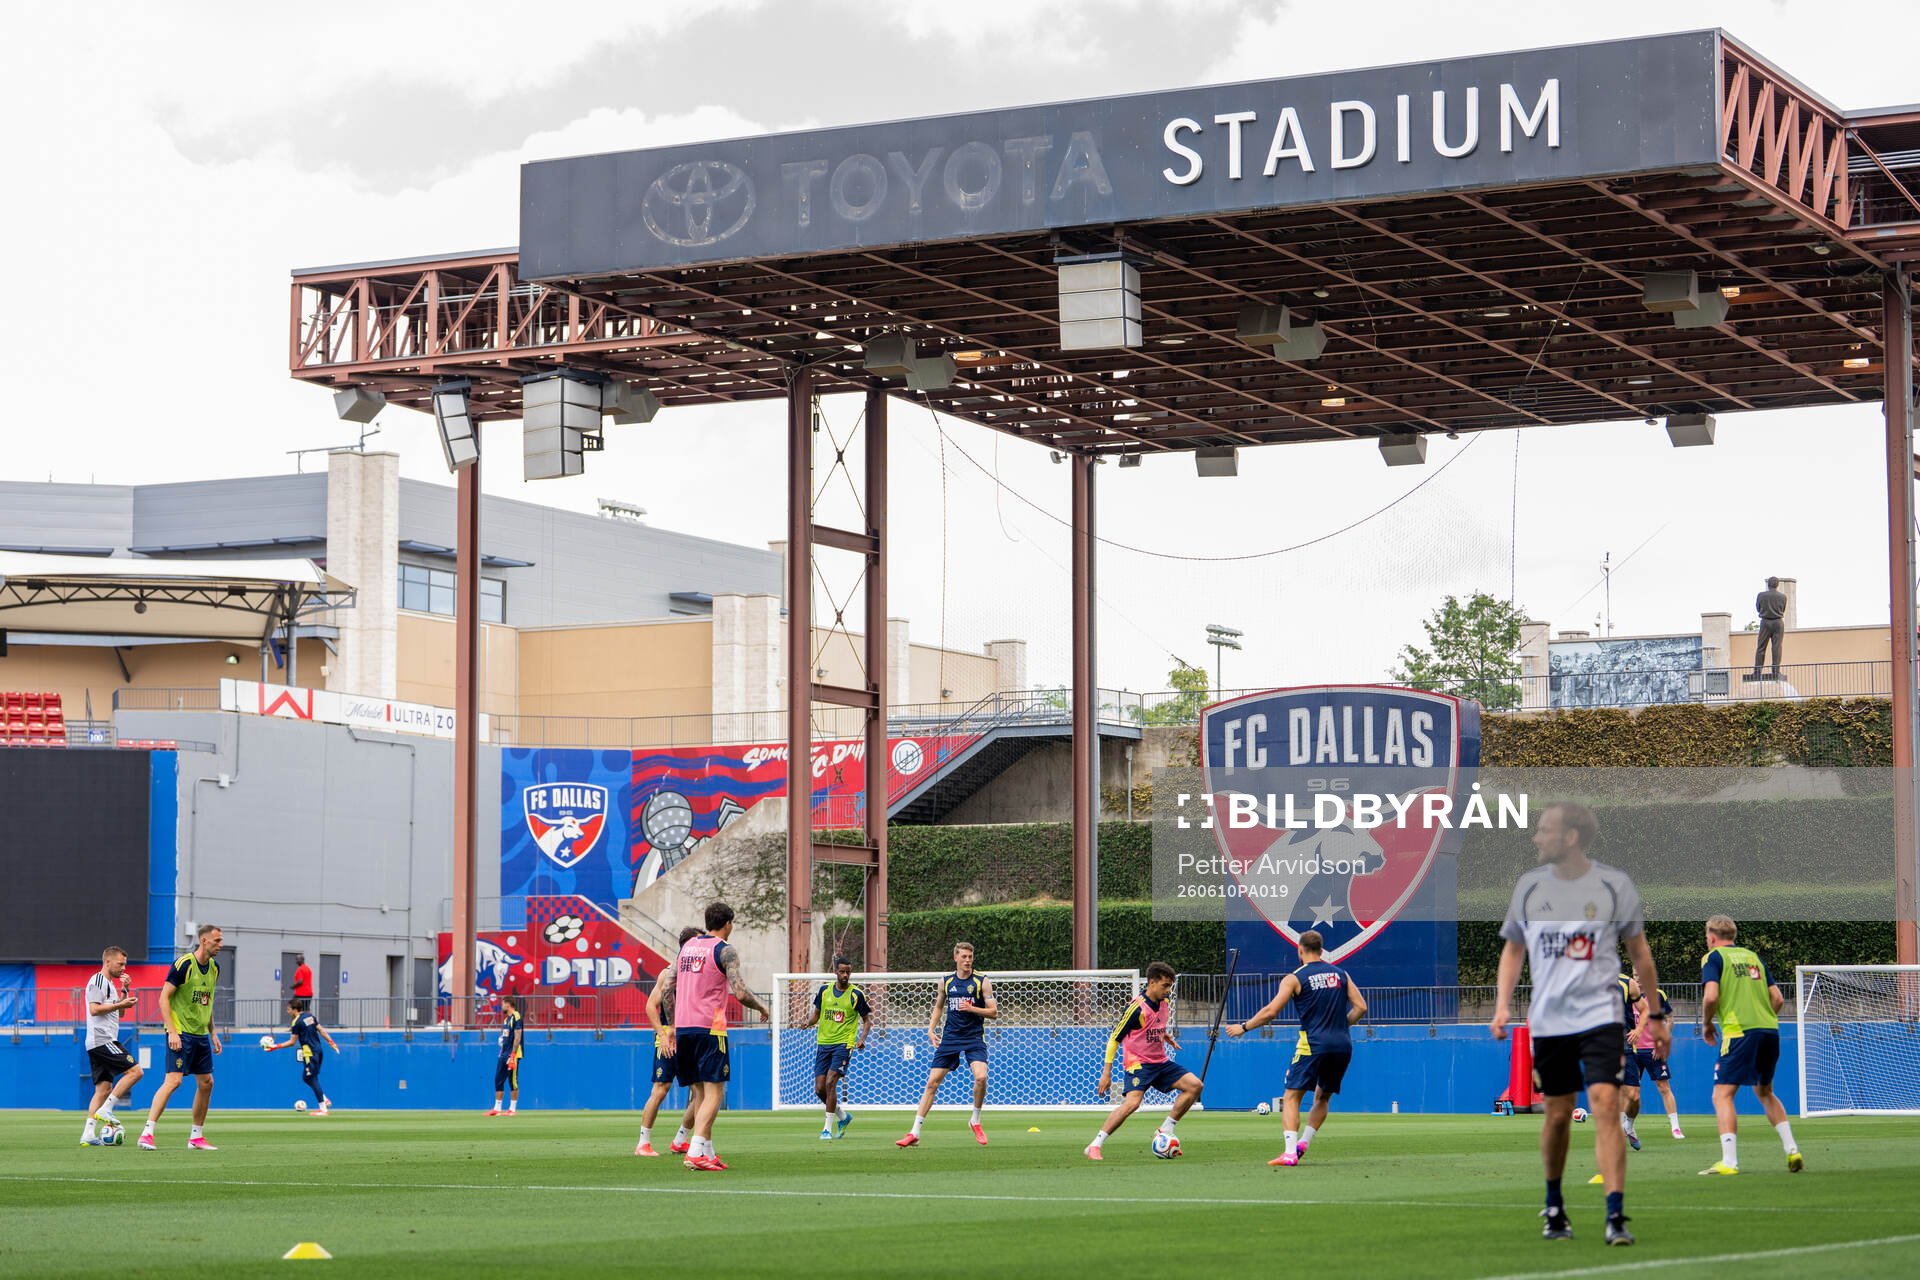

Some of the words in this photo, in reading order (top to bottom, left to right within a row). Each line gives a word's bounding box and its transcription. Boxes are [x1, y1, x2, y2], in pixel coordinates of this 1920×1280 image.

[781, 130, 1113, 227] TOYOTA
[1162, 78, 1561, 186] STADIUM
[393, 708, 431, 726] ULTRA
[1224, 713, 1268, 776] FC
[1289, 705, 1434, 769] DALLAS
[530, 789, 547, 810] FC
[552, 787, 601, 809] DALLAS
[1307, 778, 1350, 792] 96
[541, 956, 632, 987] DTID
